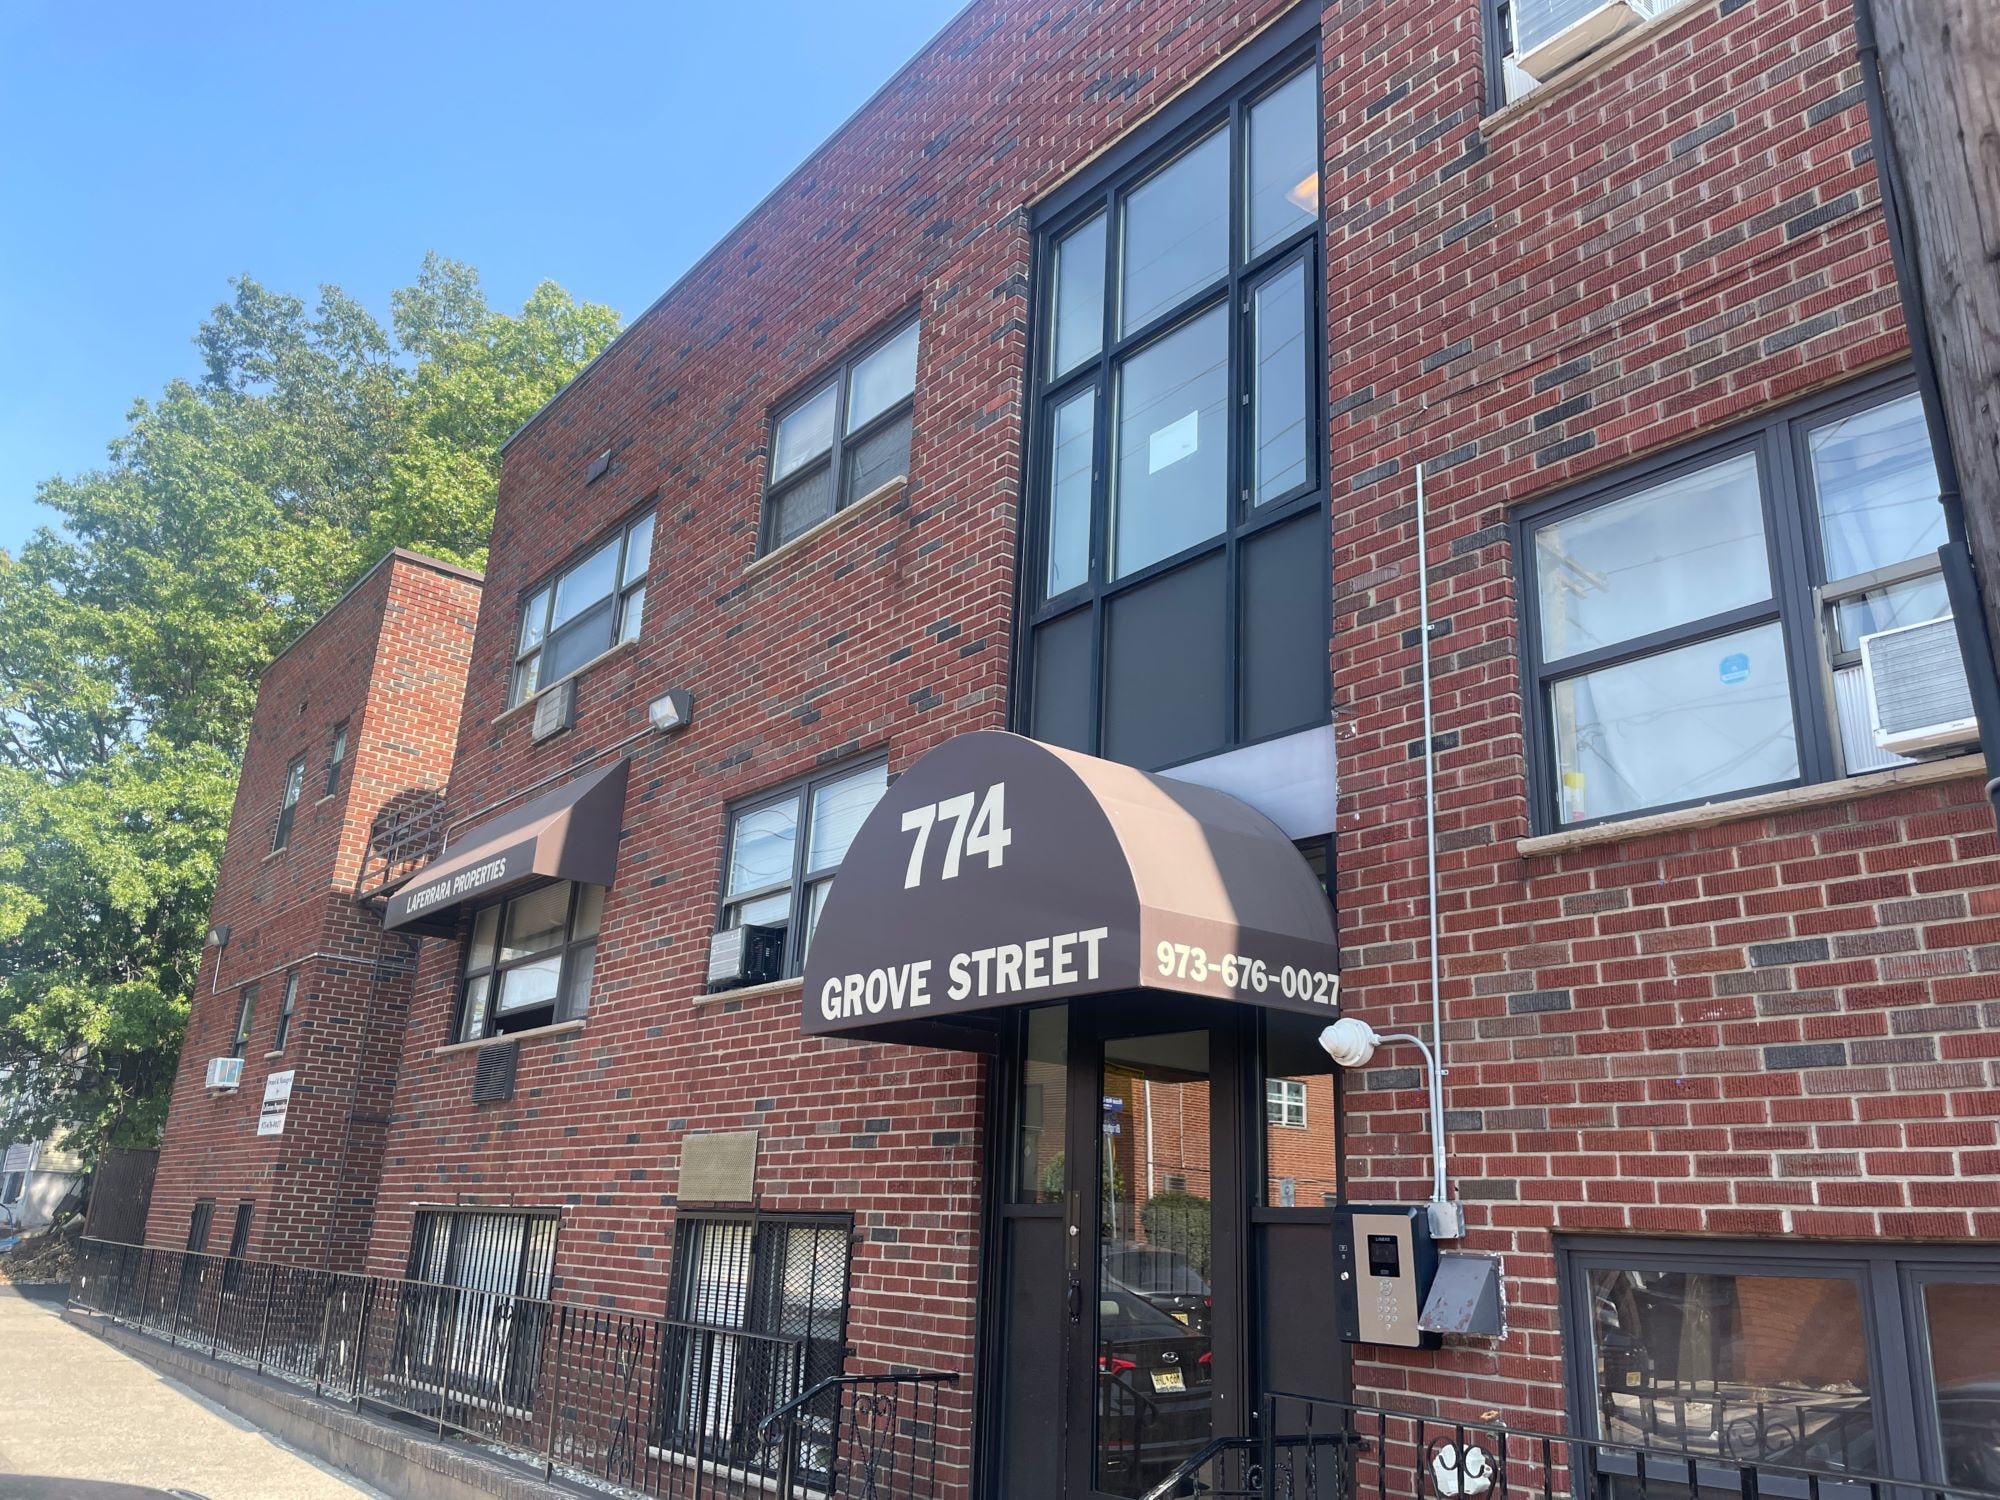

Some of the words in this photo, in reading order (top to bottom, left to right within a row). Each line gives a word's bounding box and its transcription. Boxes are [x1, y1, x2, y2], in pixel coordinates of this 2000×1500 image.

[901, 782, 1011, 889] 774
[406, 880, 450, 913] LAFERRARA
[453, 857, 506, 895] PROPERTIES
[820, 960, 931, 1021] GROVE
[947, 927, 1108, 1001] STREET
[1156, 940, 1340, 1006] 973-676-0027
